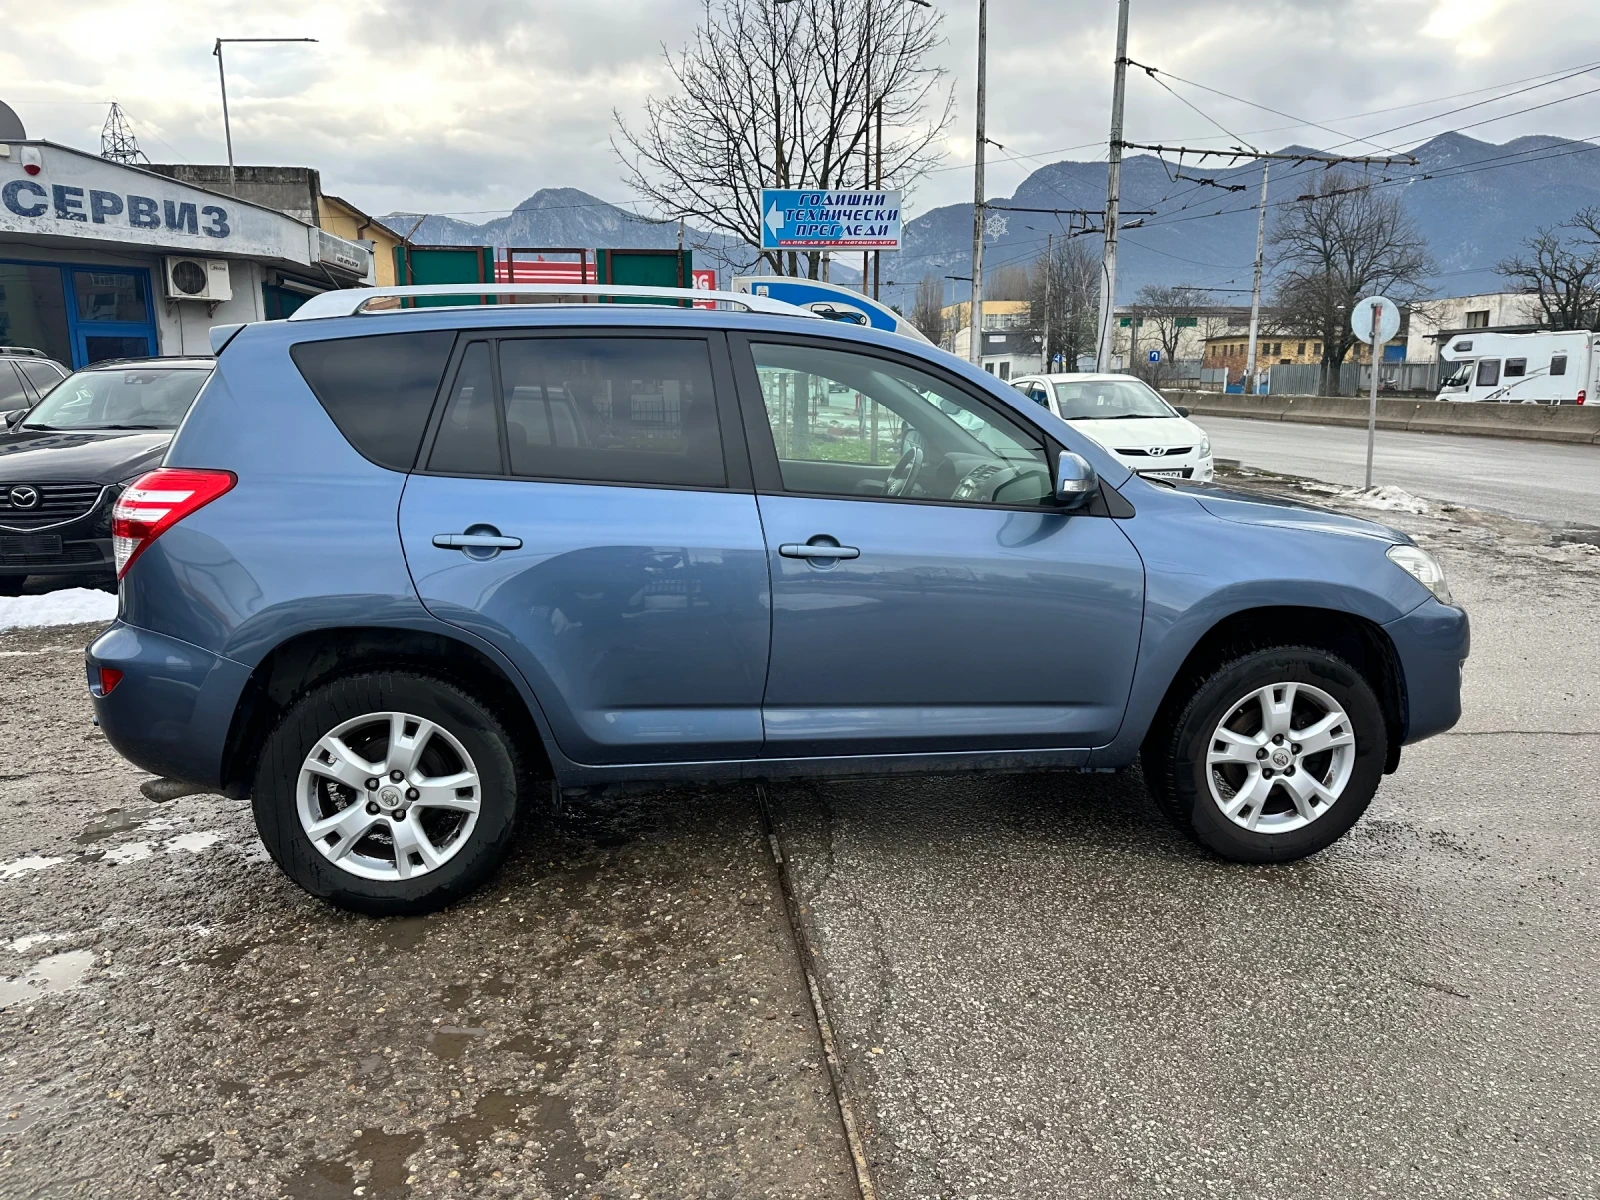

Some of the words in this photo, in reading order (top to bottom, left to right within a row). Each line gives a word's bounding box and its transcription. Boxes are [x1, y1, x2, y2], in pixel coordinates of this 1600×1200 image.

[799, 194, 886, 206] ГОДИШНИ
[2, 180, 230, 238] СЕРВИЗ
[786, 209, 899, 221] ТЕХНИЧЕСКИ
[795, 224, 889, 236] ПРЕГЛЕДИ
